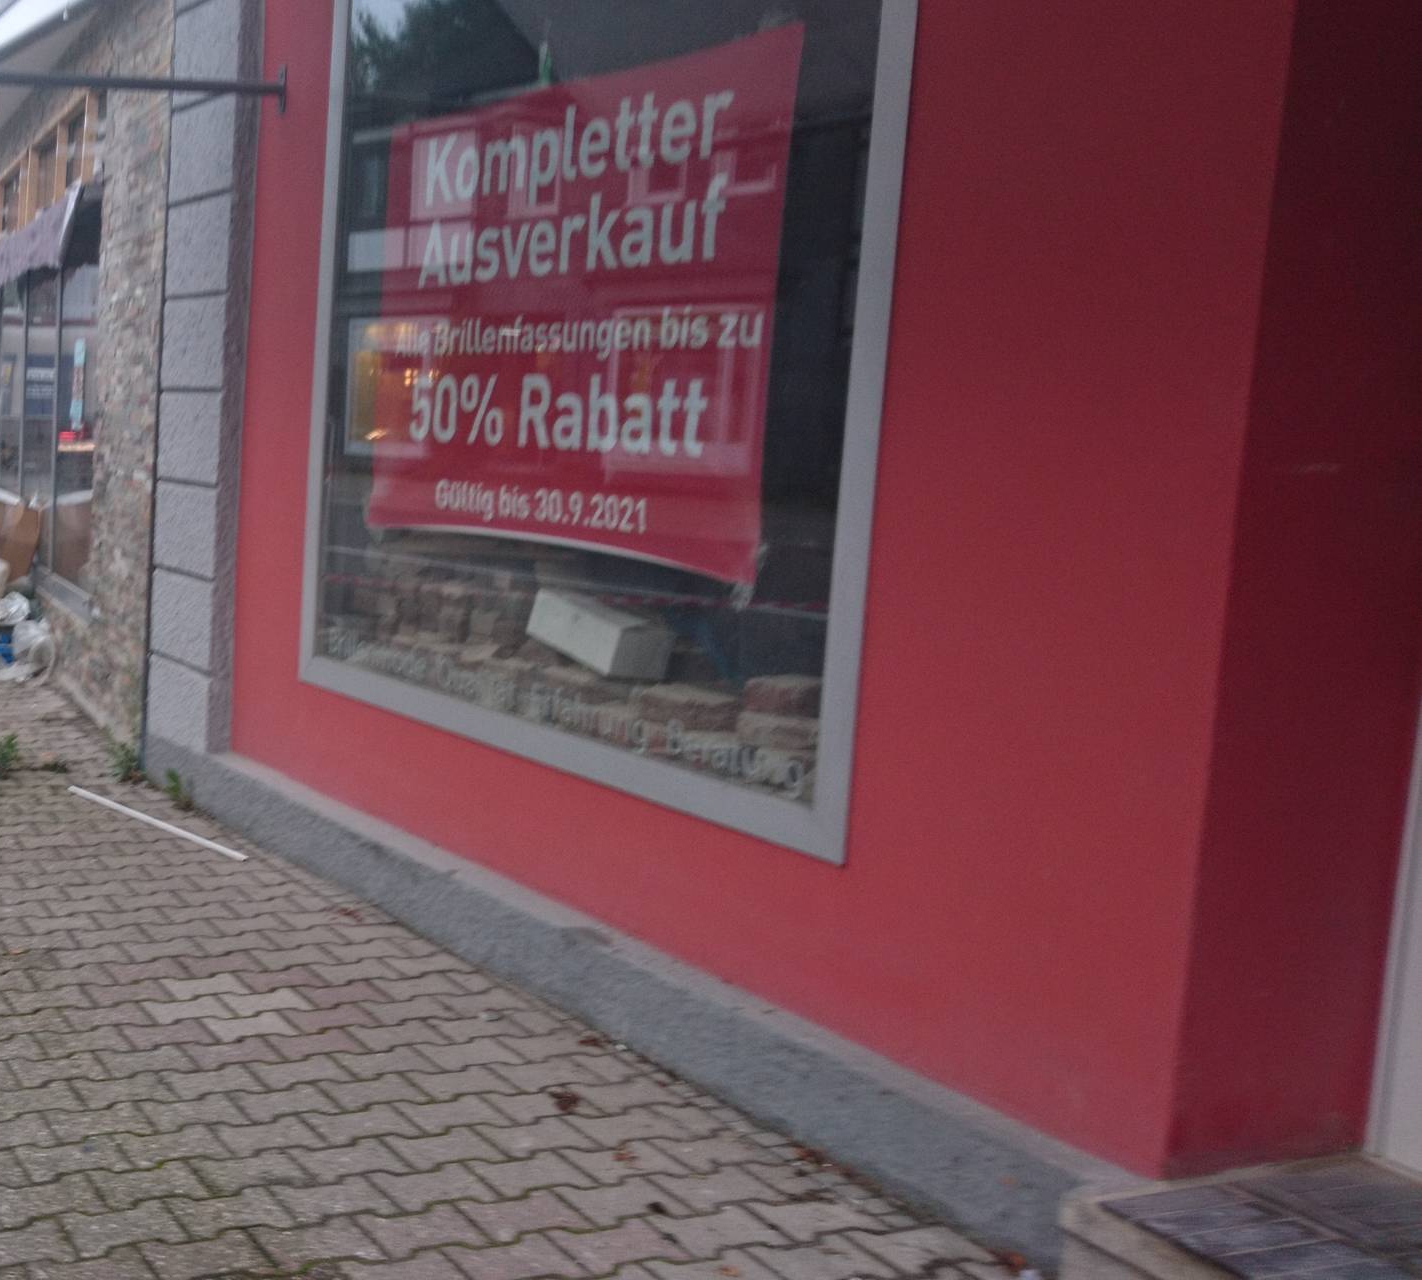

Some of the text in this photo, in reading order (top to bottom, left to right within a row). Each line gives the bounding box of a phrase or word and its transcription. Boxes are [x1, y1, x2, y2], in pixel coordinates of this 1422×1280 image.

[425, 90, 735, 211] Kompletter
[418, 172, 729, 289] Ausverkauf
[395, 306, 765, 360] Alle Brillenfassungen bis zu
[409, 373, 708, 459] 50% Rabatt
[435, 478, 648, 536] Gültig bis 30.9.2021
